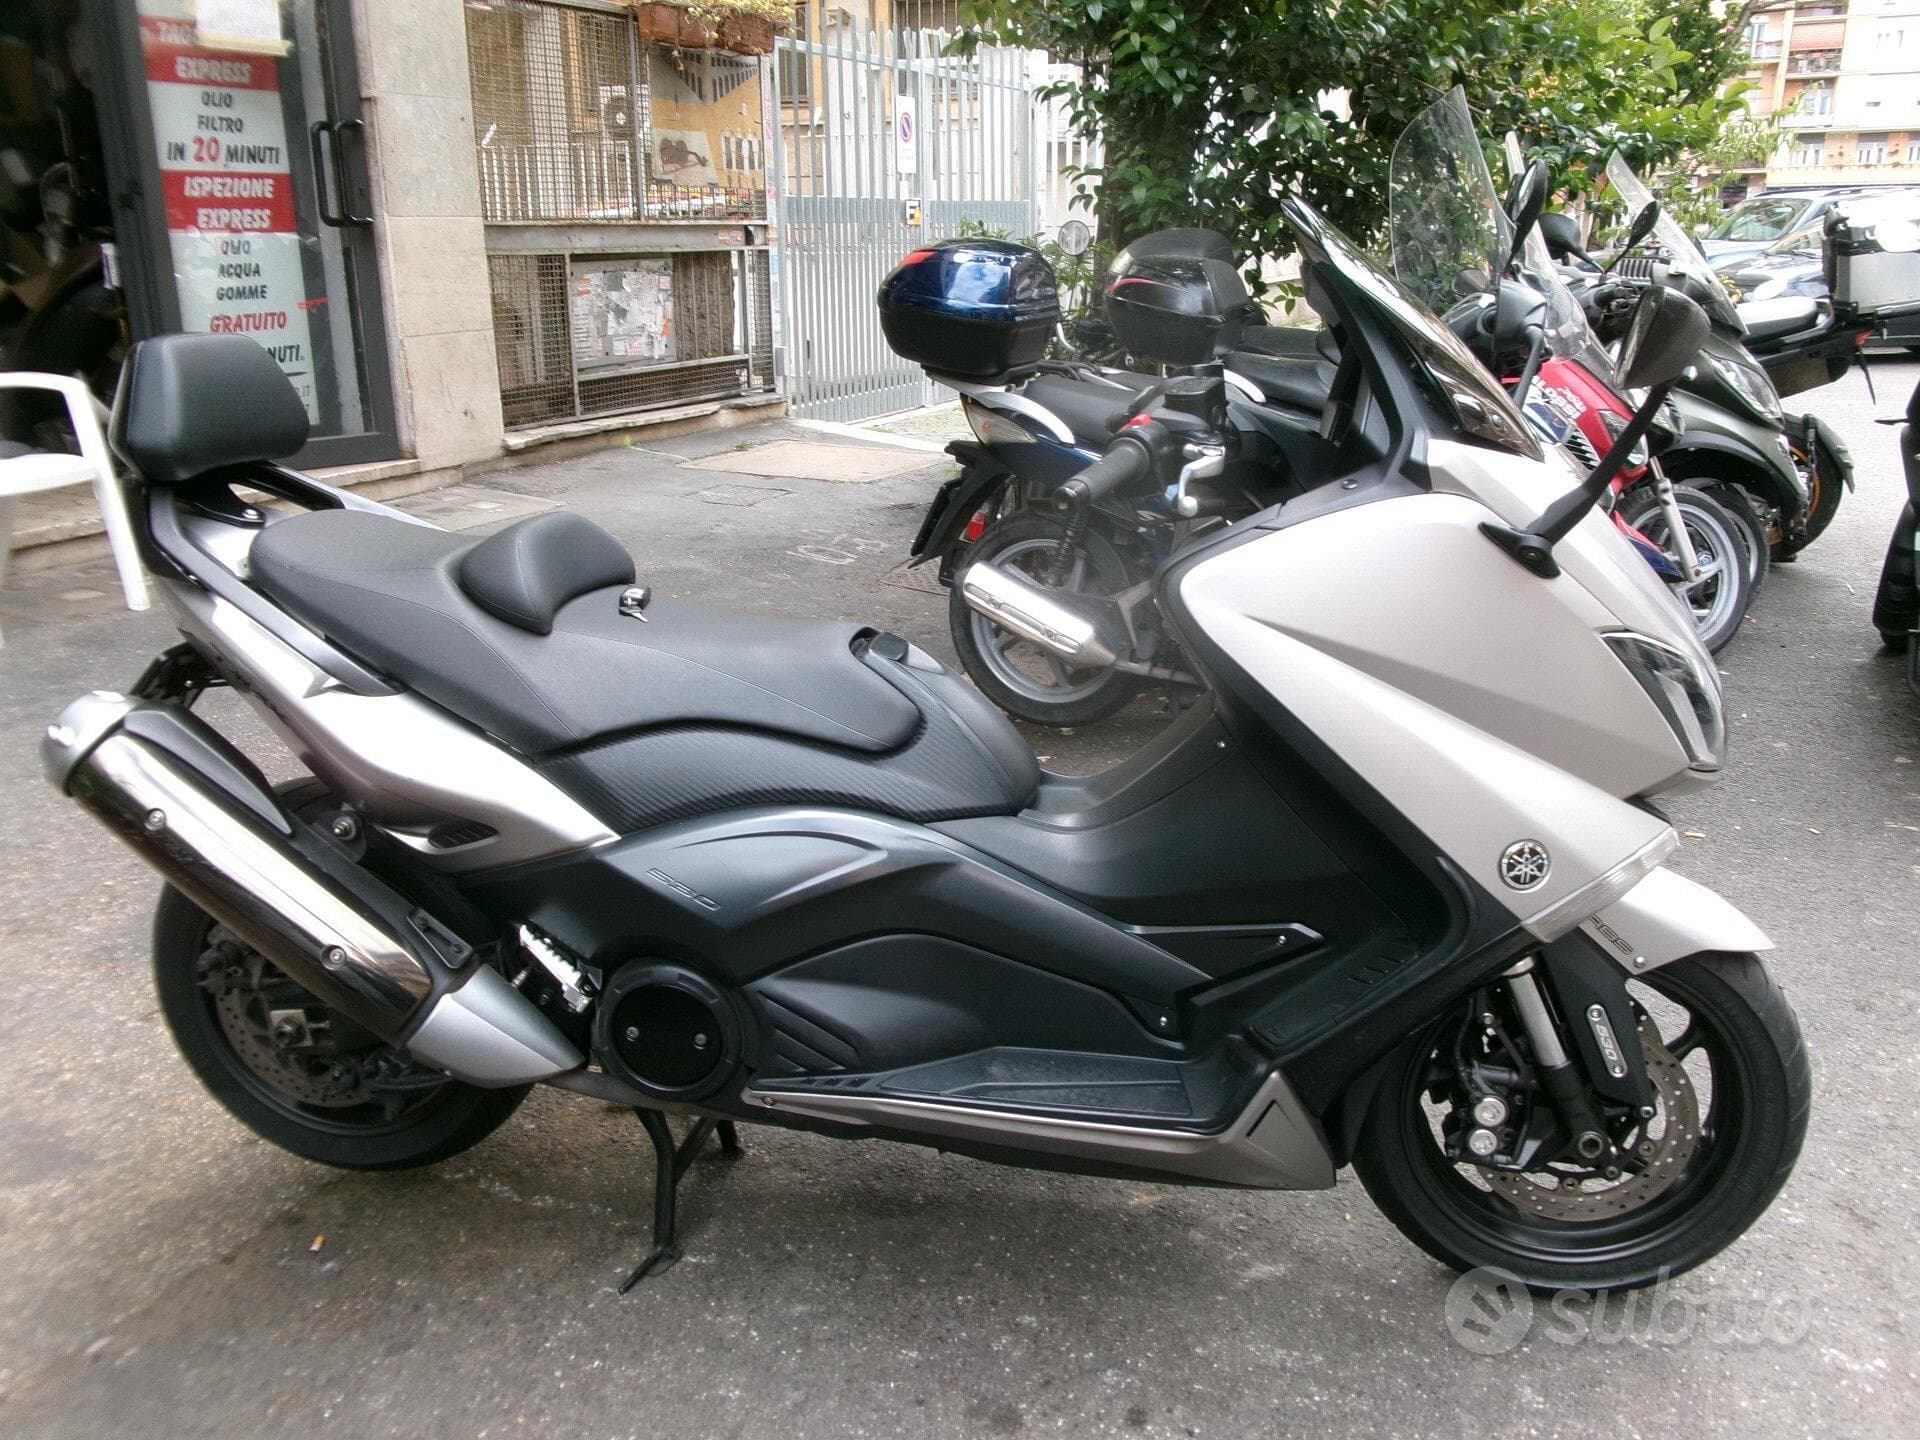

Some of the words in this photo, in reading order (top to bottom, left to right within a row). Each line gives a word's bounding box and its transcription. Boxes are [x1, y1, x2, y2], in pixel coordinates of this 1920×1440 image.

[175, 56, 251, 84] EXPRESS
[201, 91, 233, 108] OLIO
[197, 115, 244, 134] FILTRO
[167, 142, 185, 161] IN
[192, 136, 220, 162] 20
[225, 144, 280, 164] MINUTI
[183, 176, 275, 199] ISPEZIONE
[197, 208, 272, 229] EXPRESS
[217, 263, 261, 279] ACQUA
[216, 285, 268, 301] GOMME
[209, 311, 288, 333] GRATUITO
[267, 344, 304, 363] NUTI.
[1595, 1024, 1617, 1061] 530
